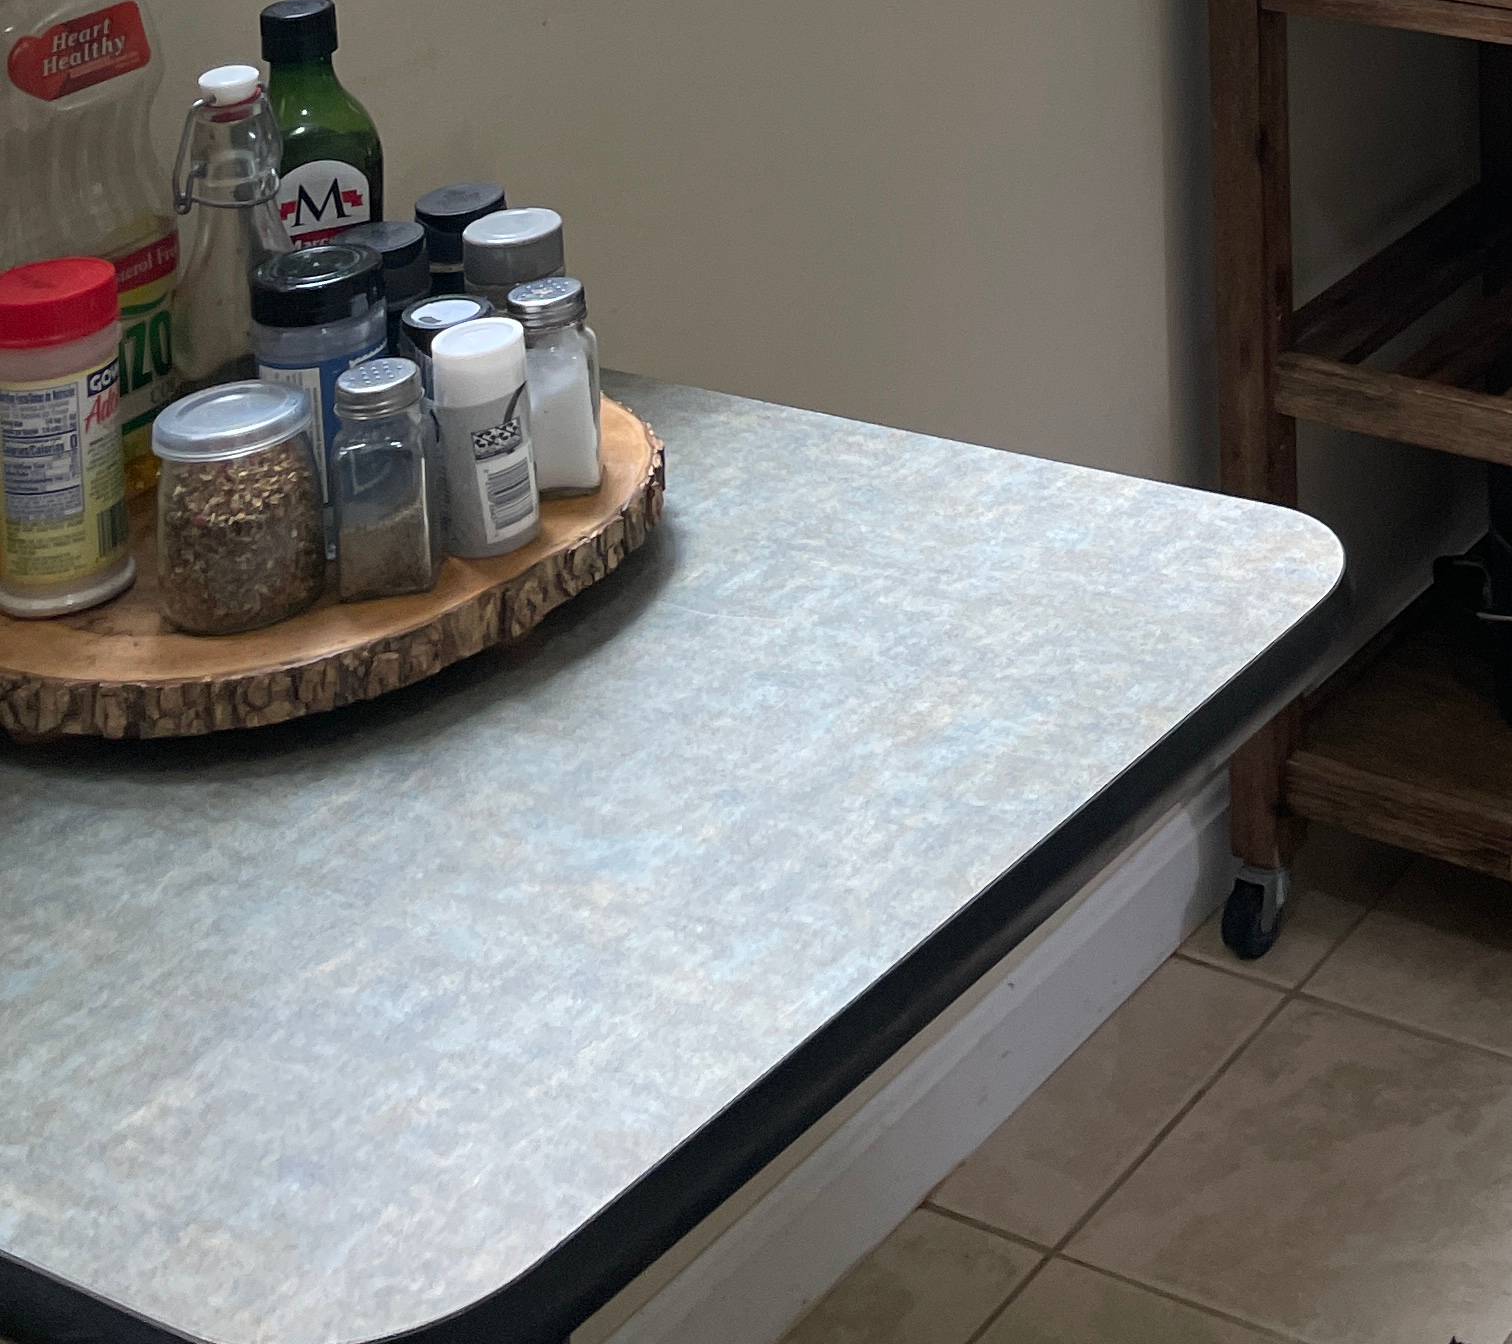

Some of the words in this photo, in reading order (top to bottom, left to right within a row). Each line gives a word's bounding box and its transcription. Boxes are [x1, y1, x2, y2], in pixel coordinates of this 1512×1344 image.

[42, 35, 126, 77] Healthy
[52, 18, 111, 53] Heart
[291, 178, 352, 228] M
